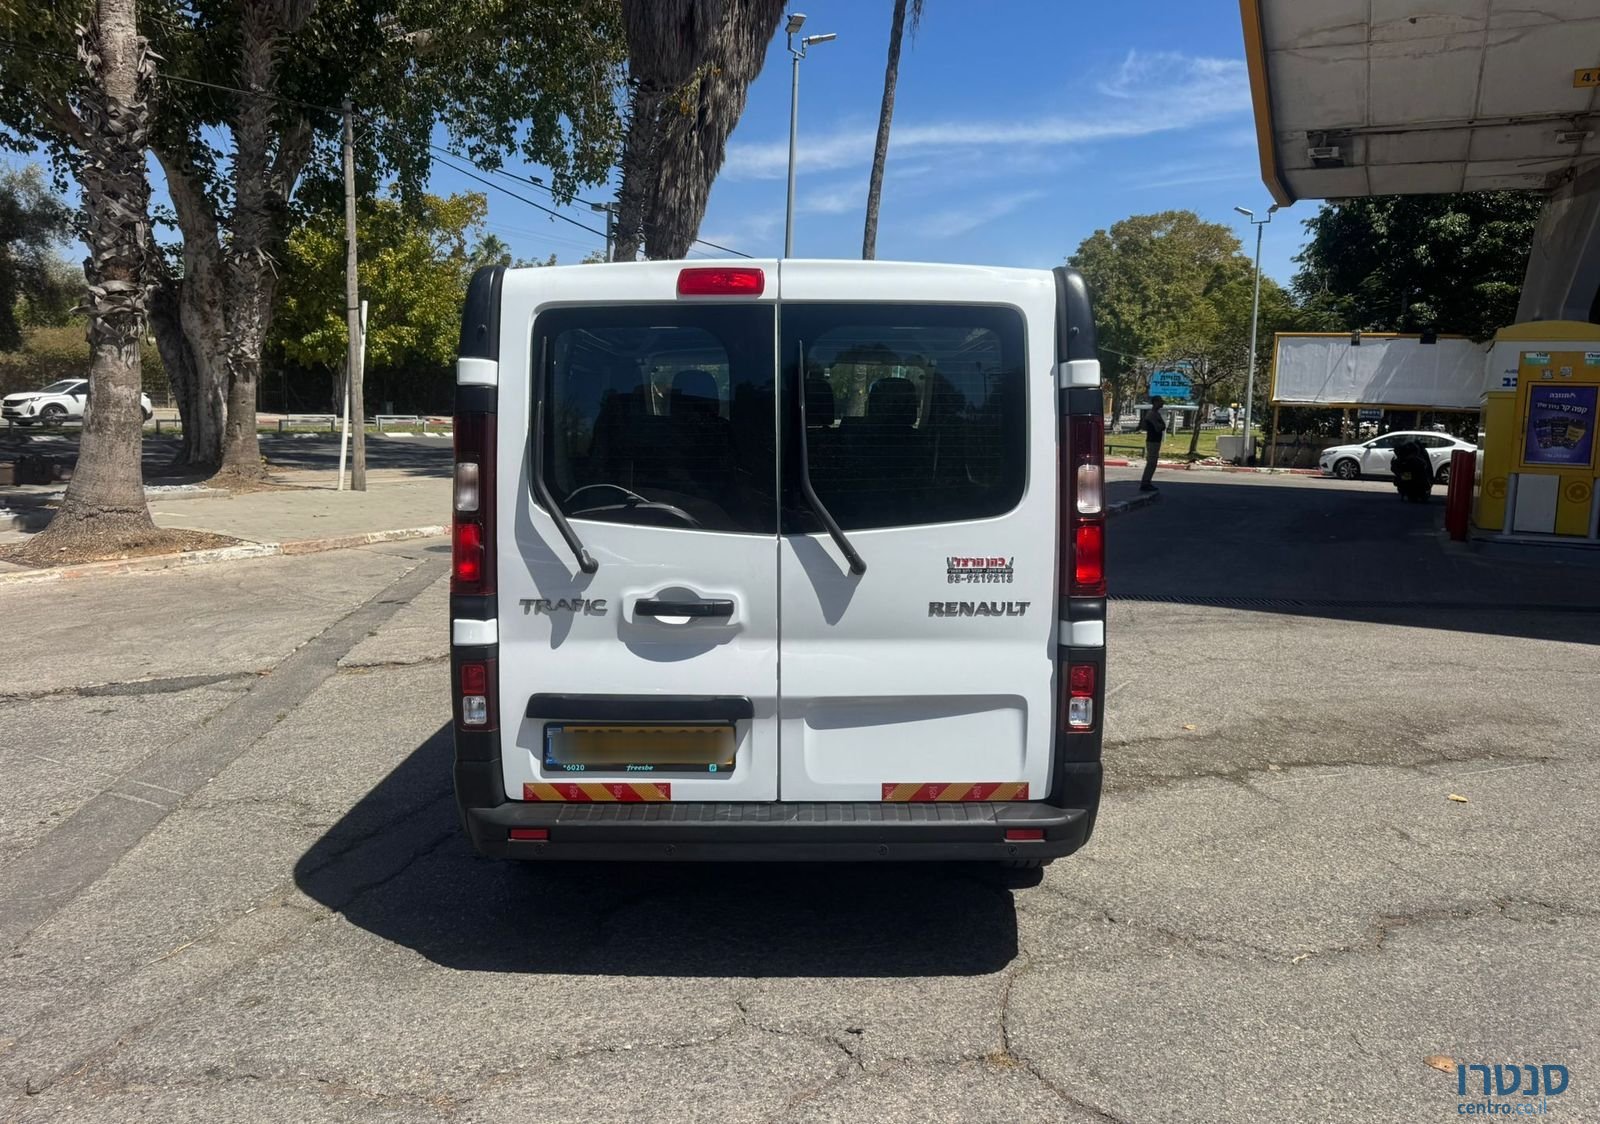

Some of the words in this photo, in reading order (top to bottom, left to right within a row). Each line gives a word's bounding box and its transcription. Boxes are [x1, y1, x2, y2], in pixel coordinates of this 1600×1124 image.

[518, 598, 609, 617] TRAFIC
[928, 601, 1031, 618] RENAULT
[626, 764, 654, 772] freesbe
